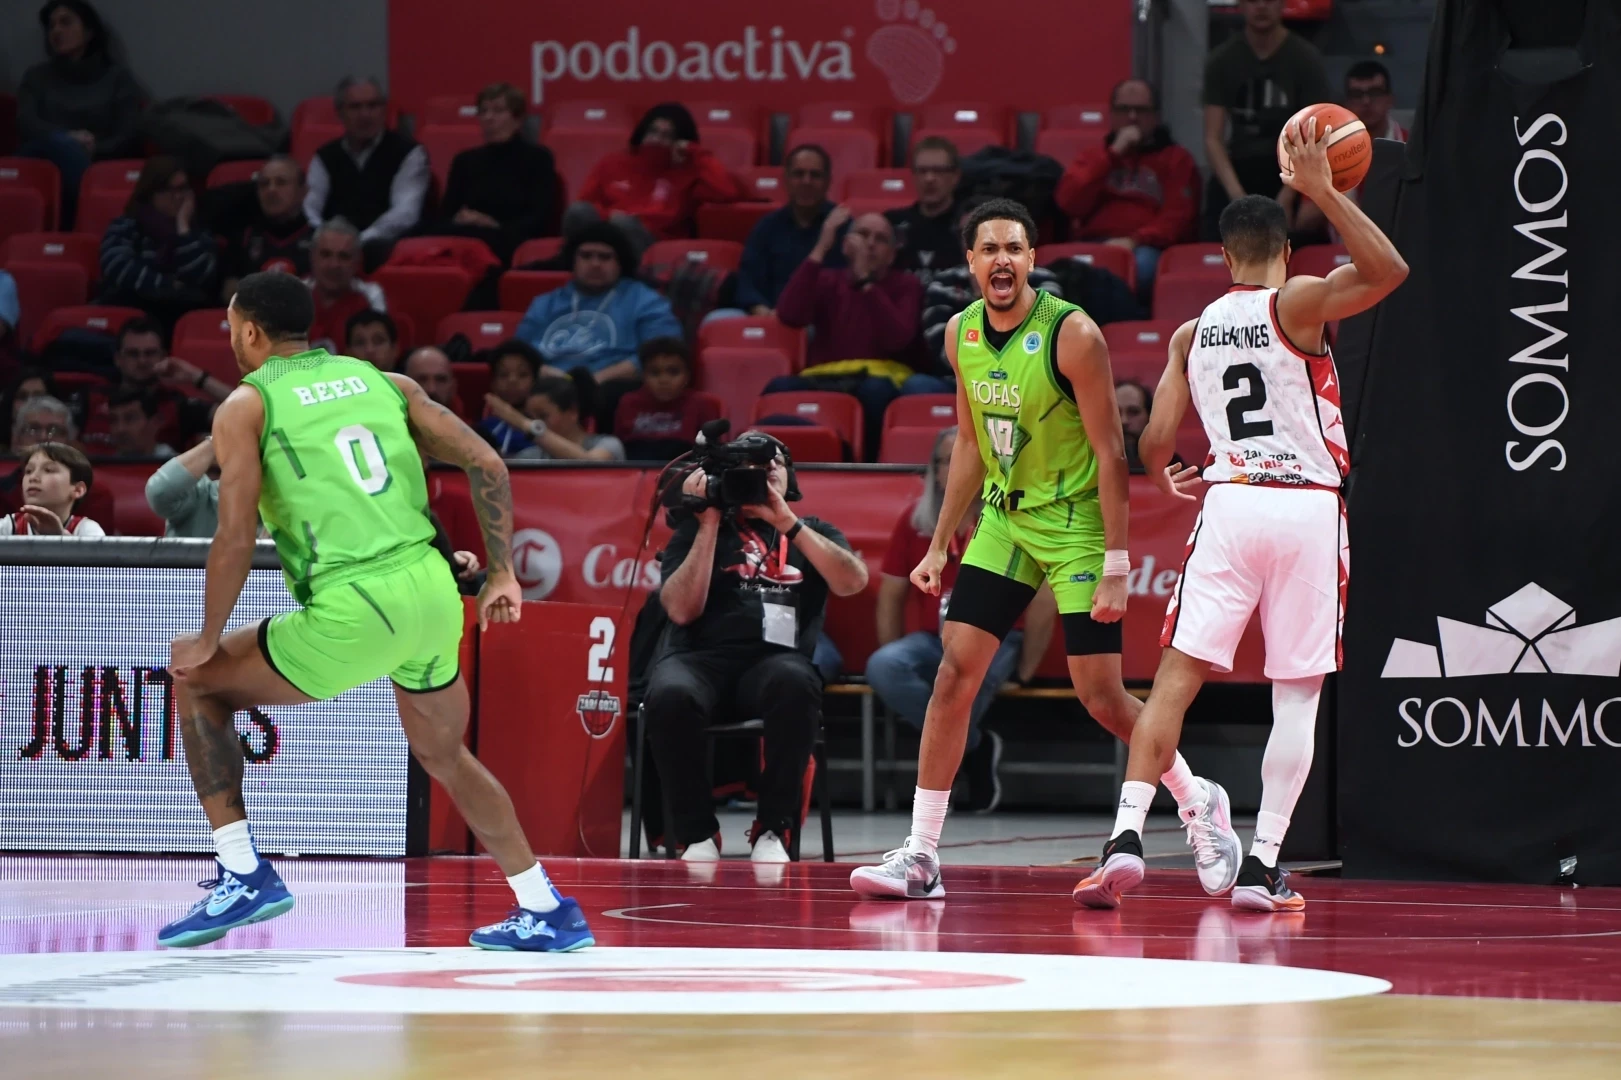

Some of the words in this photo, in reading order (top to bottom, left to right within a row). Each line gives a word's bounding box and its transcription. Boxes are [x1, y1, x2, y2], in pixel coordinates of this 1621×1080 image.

[531, 26, 855, 104] podoactiva
[1333, 139, 1367, 163] molten
[1505, 112, 1570, 472] SOMMOS
[292, 375, 369, 406] REED
[971, 380, 1020, 414] TOFAŞ
[1222, 362, 1274, 441] 2
[333, 424, 393, 497] 0
[587, 616, 616, 683] 2
